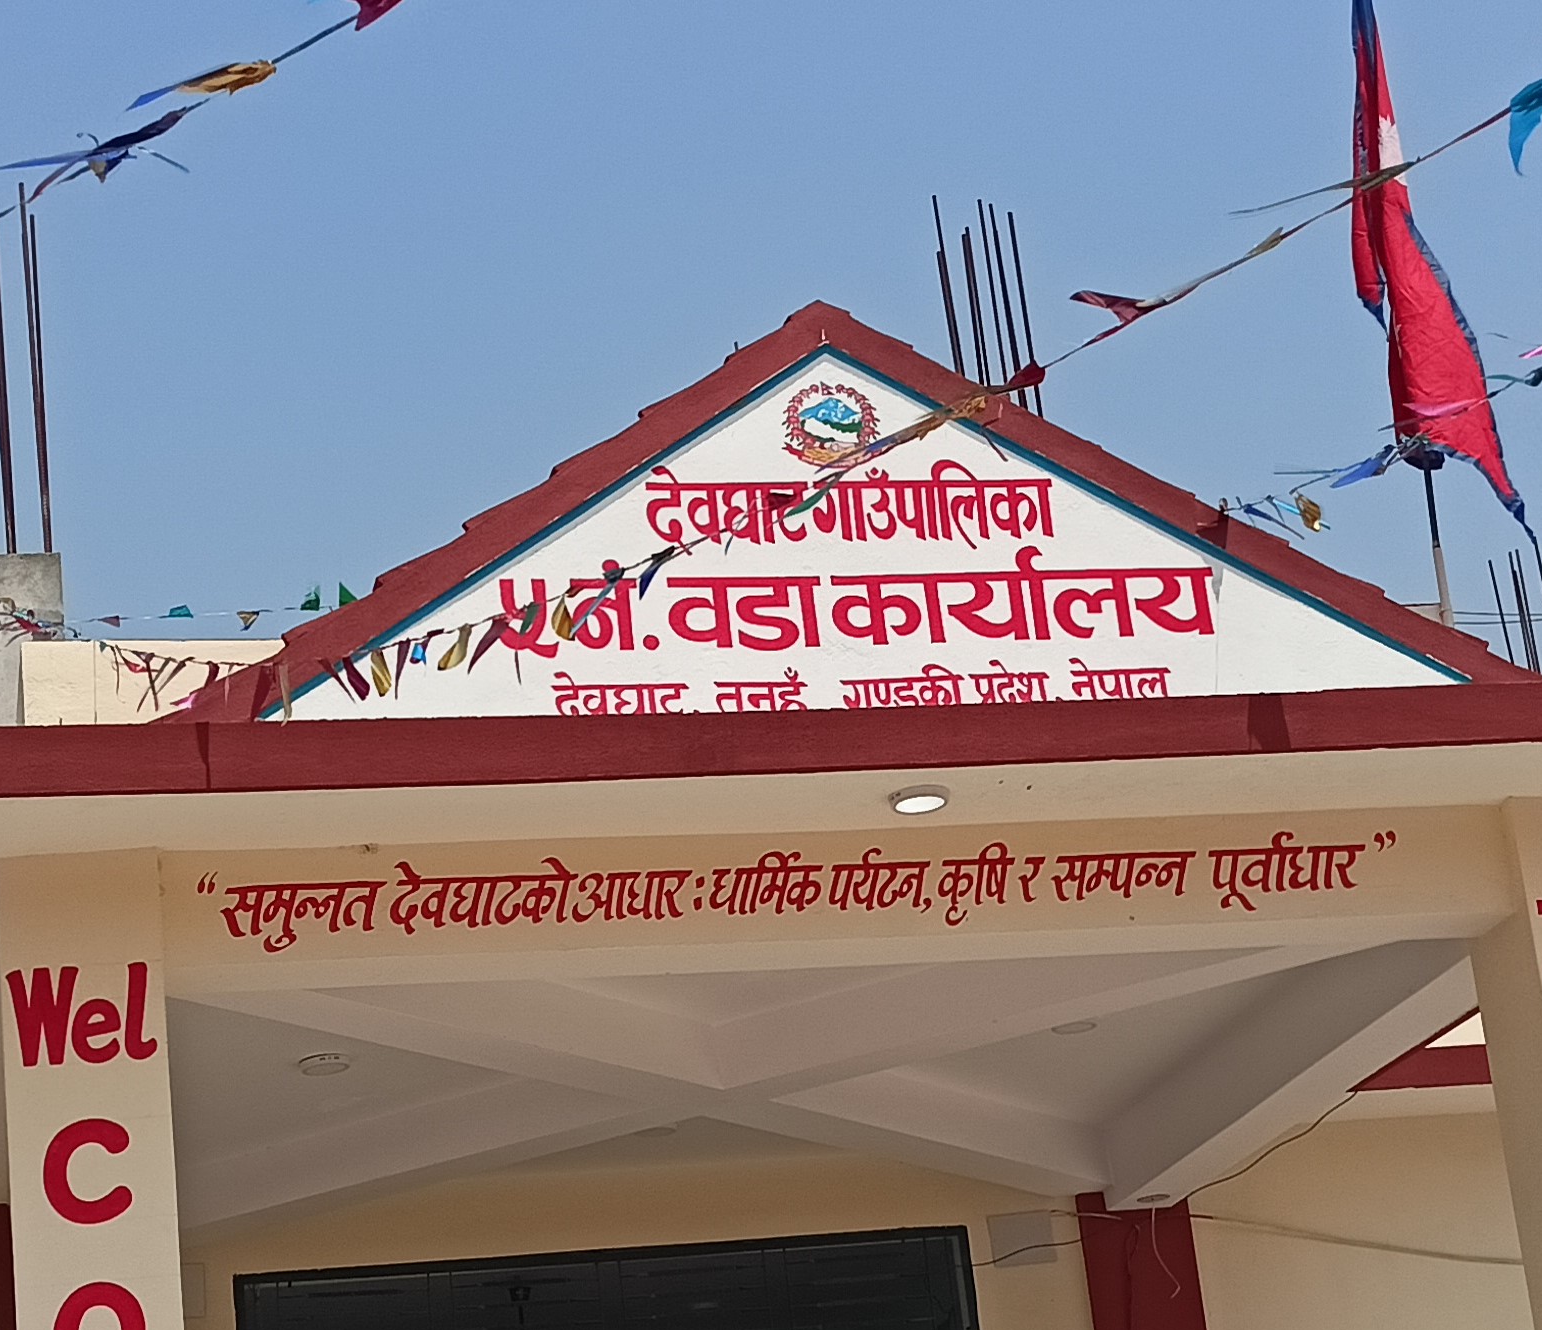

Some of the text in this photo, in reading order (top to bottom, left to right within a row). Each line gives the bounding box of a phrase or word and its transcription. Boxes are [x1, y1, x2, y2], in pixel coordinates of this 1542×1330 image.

[646, 460, 1054, 556] देवघाट गाउँपालिका
[667, 577, 821, 651] वडा
[831, 546, 1215, 645] कार्यालय
[1068, 657, 1171, 700] नेपाल
[390, 857, 577, 934] देवघाटको
[709, 851, 823, 915] धार्मिक
[828, 848, 933, 913] पर्यटन,
[938, 842, 1015, 926] कृषि
[1018, 857, 1046, 902] र
[1051, 851, 1196, 901] सम्पन्न
